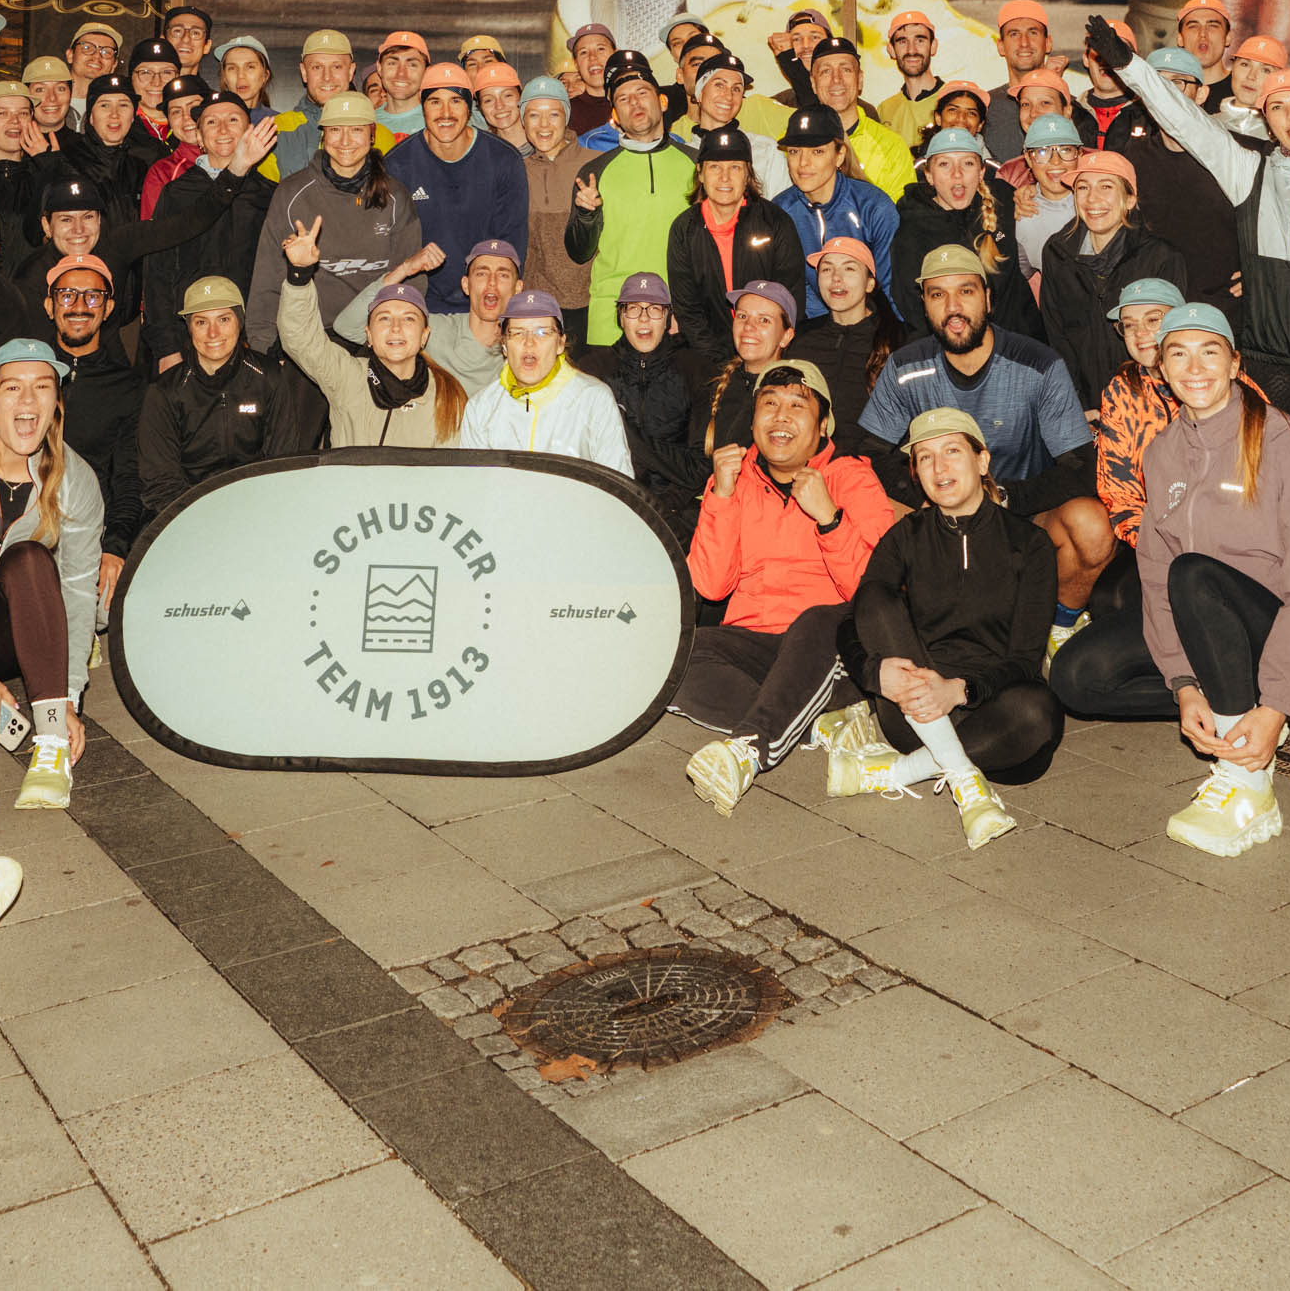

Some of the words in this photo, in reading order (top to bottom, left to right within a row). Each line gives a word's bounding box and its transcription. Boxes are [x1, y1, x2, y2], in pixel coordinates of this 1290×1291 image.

[313, 502, 497, 582] SCHUSTER
[164, 604, 231, 619] schuster
[549, 604, 616, 619] schuster
[302, 640, 394, 722] TEAM
[407, 645, 490, 721] 1913
